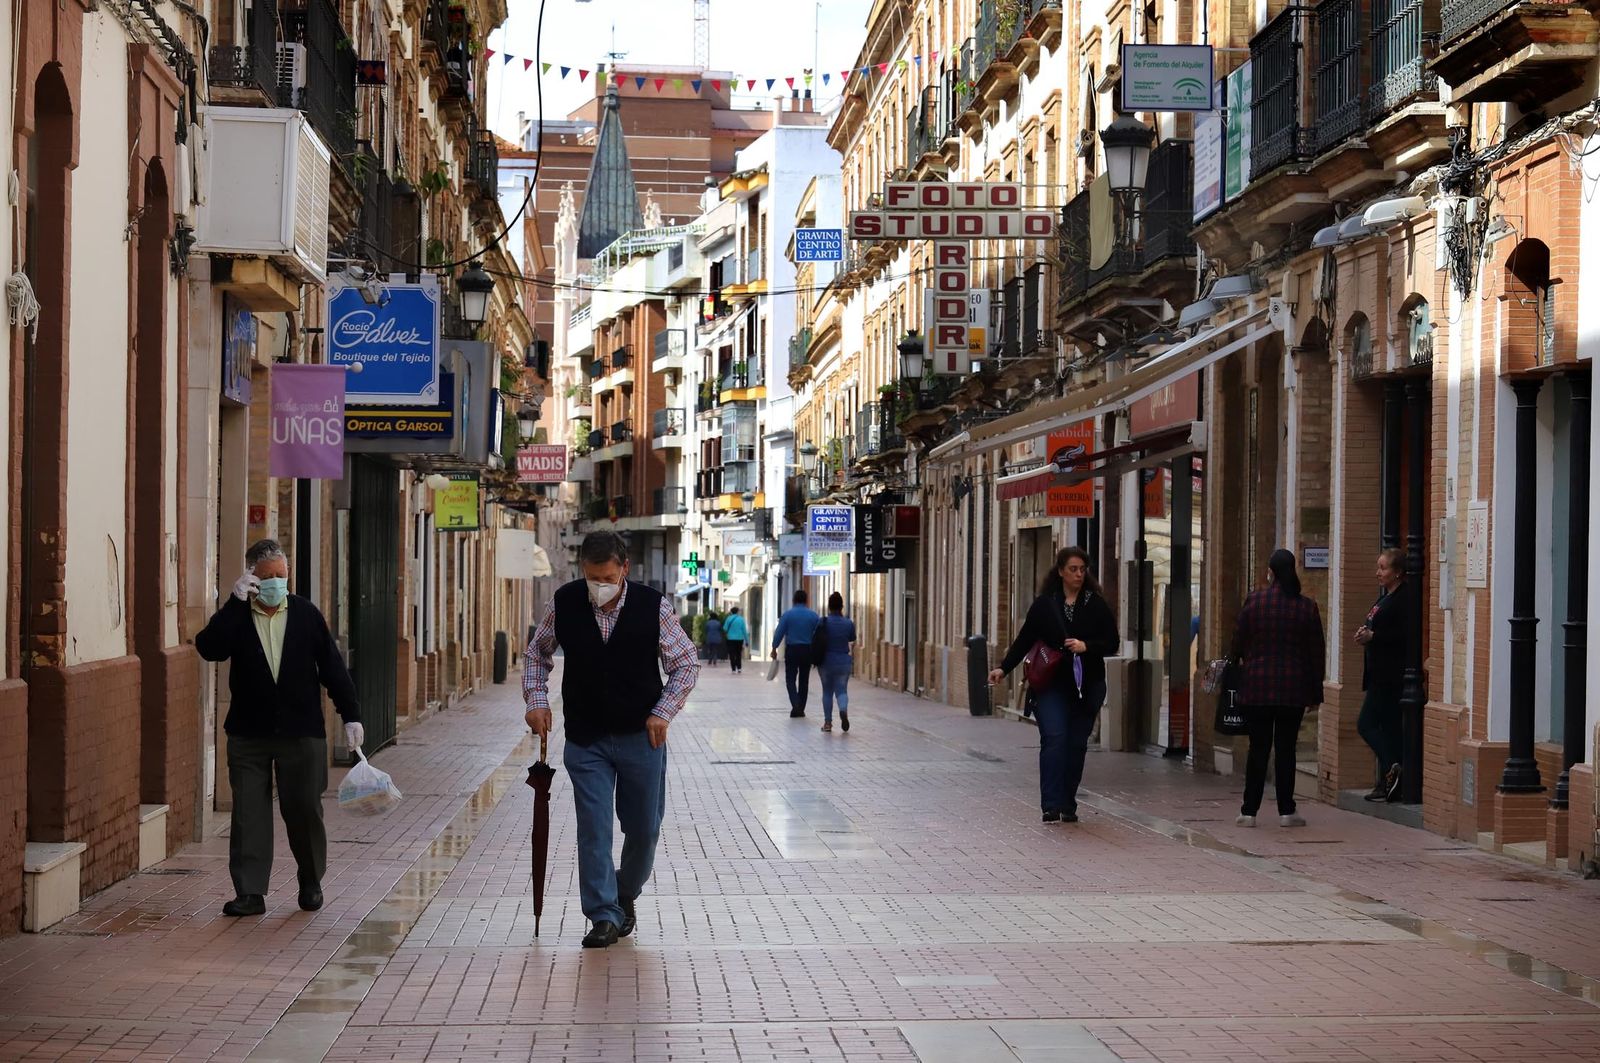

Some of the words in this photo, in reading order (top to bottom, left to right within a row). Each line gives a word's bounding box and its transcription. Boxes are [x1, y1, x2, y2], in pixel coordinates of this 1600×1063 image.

[1133, 51, 1158, 60] Agencia
[1181, 61, 1204, 70] Alquiler
[888, 185, 1016, 206] FOTO
[854, 215, 1050, 235] STUDIO
[797, 231, 840, 240] GRAVINA
[798, 240, 840, 249] CENTRO
[800, 250, 813, 259] DE
[814, 250, 840, 259] ARTE
[938, 245, 966, 371] RODRI
[332, 310, 431, 348] Gálvez
[334, 352, 379, 363] Boutique
[381, 353, 397, 362] del
[401, 353, 430, 364] Tejido
[272, 415, 341, 446] UÑAS
[347, 419, 392, 431] OPTICA
[395, 420, 444, 432] GARSOL
